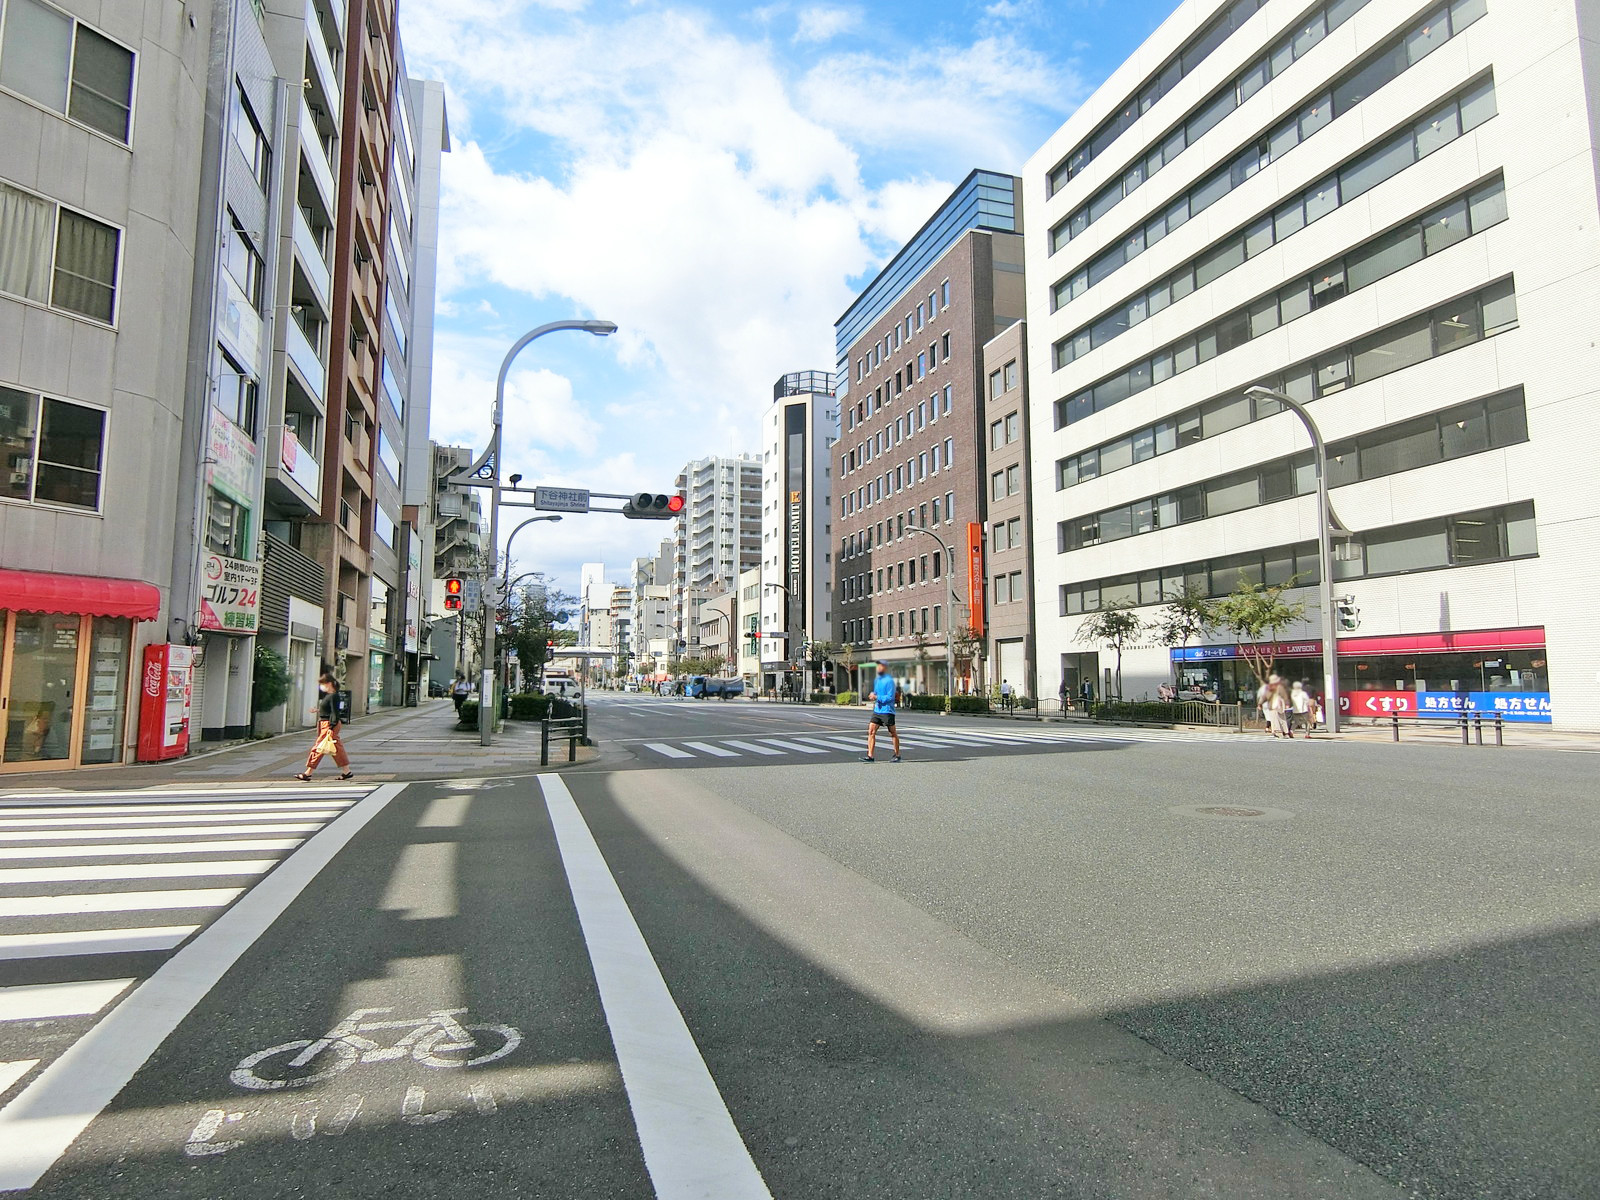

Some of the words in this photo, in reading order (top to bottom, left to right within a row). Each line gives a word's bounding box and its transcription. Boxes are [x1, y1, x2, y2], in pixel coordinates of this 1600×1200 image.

[539, 490, 588, 502] 下谷神社前
[791, 504, 800, 533] EMIT
[791, 534, 800, 573] HOTEL
[224, 559, 259, 574] 24時間OPEN
[973, 556, 981, 605] 東京スター銀行
[204, 583, 257, 608] ゴルフ24
[224, 611, 256, 630] 練習場
[1287, 645, 1316, 653] LAWSON
[1366, 696, 1408, 711] くすり
[1425, 696, 1476, 709] 処方せん
[1494, 697, 1552, 710] 処方せん
